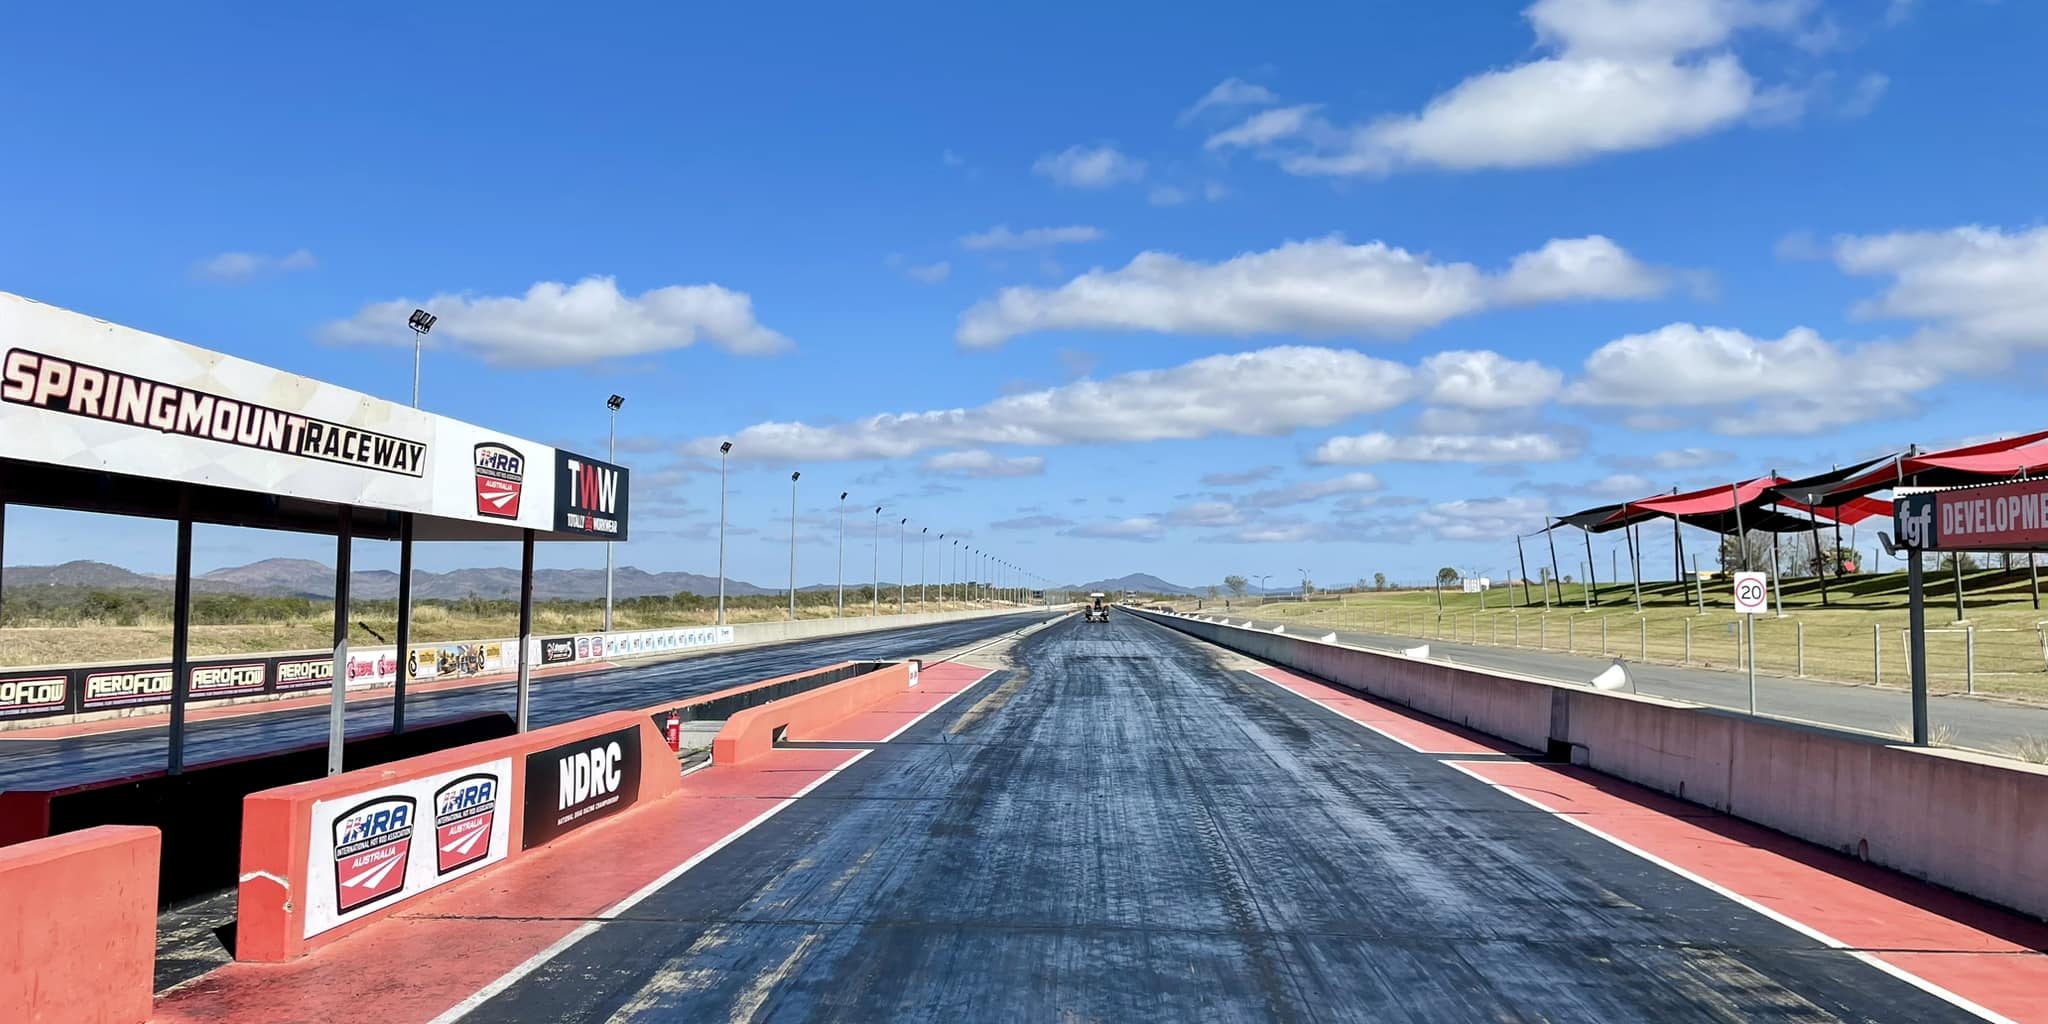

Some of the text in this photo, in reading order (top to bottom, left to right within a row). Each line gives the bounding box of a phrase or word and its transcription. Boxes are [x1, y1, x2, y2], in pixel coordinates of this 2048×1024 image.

[3, 352, 423, 472] SPRINGMOUNT RACEWAY
[485, 479, 513, 491] AUSTRALIA
[567, 459, 618, 514] TWW
[1900, 500, 1931, 549] fgf
[1741, 585, 1762, 600] 20
[87, 671, 173, 699] AEROFLOW
[191, 665, 264, 690] AEROFLOW
[0, 679, 64, 705] OFLOW
[559, 741, 621, 811] NDRC
[441, 782, 492, 814] IHRA
[342, 805, 408, 844] IHRA
[448, 817, 483, 836] AUSTRALIA
[352, 847, 396, 869] AUSTRALIA
